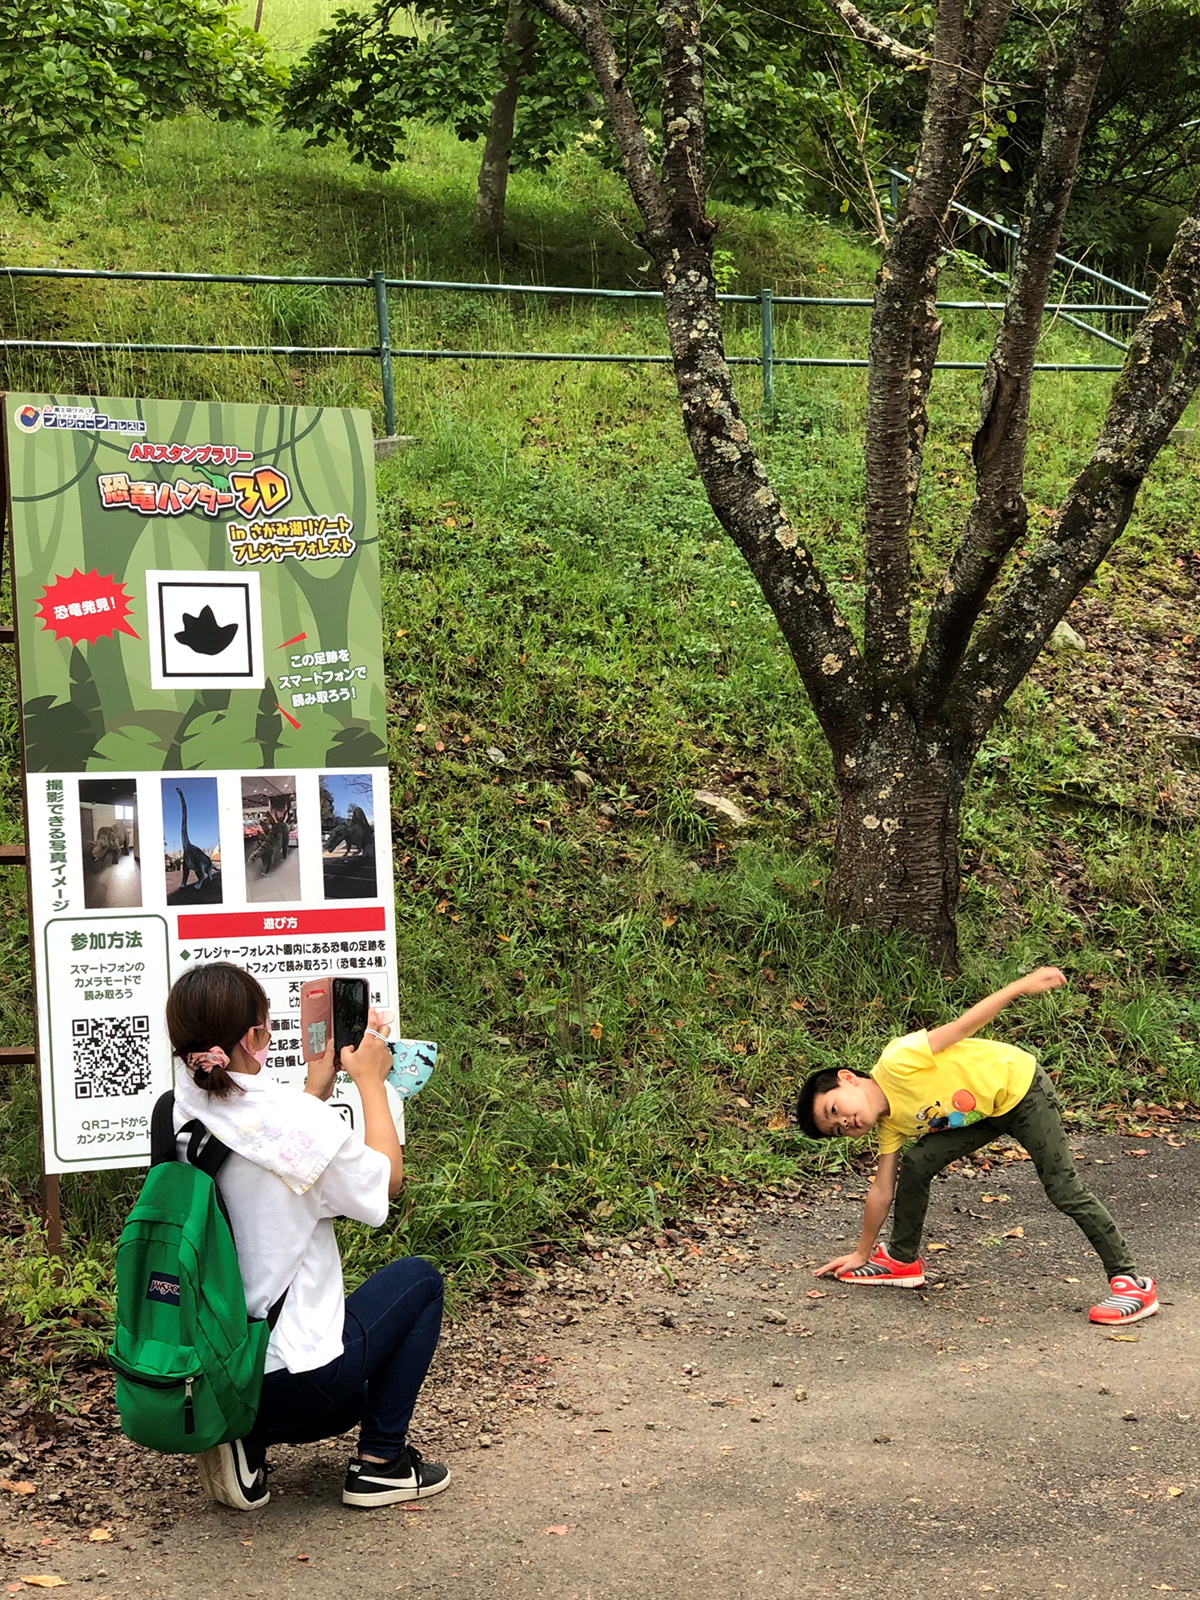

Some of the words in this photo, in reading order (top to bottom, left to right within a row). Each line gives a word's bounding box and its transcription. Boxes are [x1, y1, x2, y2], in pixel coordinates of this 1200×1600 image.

[44, 413, 146, 431] プレジャーフォレスト
[130, 444, 252, 464] ARスタンプラリー
[99, 468, 289, 516] 恐竜ハンター3D
[249, 515, 351, 541] さがみ湖リゾート
[232, 536, 353, 562] プレジャーフォレスト
[53, 596, 116, 620] 恐竜発見!
[290, 649, 350, 668] この足跡を
[278, 666, 368, 690] スマートフォンで
[291, 687, 357, 708] 読み取ろう!
[45, 779, 70, 912] 撮影できる写真イメージ
[263, 916, 298, 930] 遊び方
[70, 930, 143, 951] 参加方法
[193, 940, 386, 960] プレジャーフォレスト園内にある恐竜の足跡を
[70, 962, 145, 975] スマートフォンの
[74, 975, 142, 988] カメラモードで
[84, 988, 133, 1001] 読み取ろう
[268, 1038, 303, 1051] と記念
[81, 1116, 149, 1131] QRコードから
[76, 1129, 152, 1145] カンタンスタート
